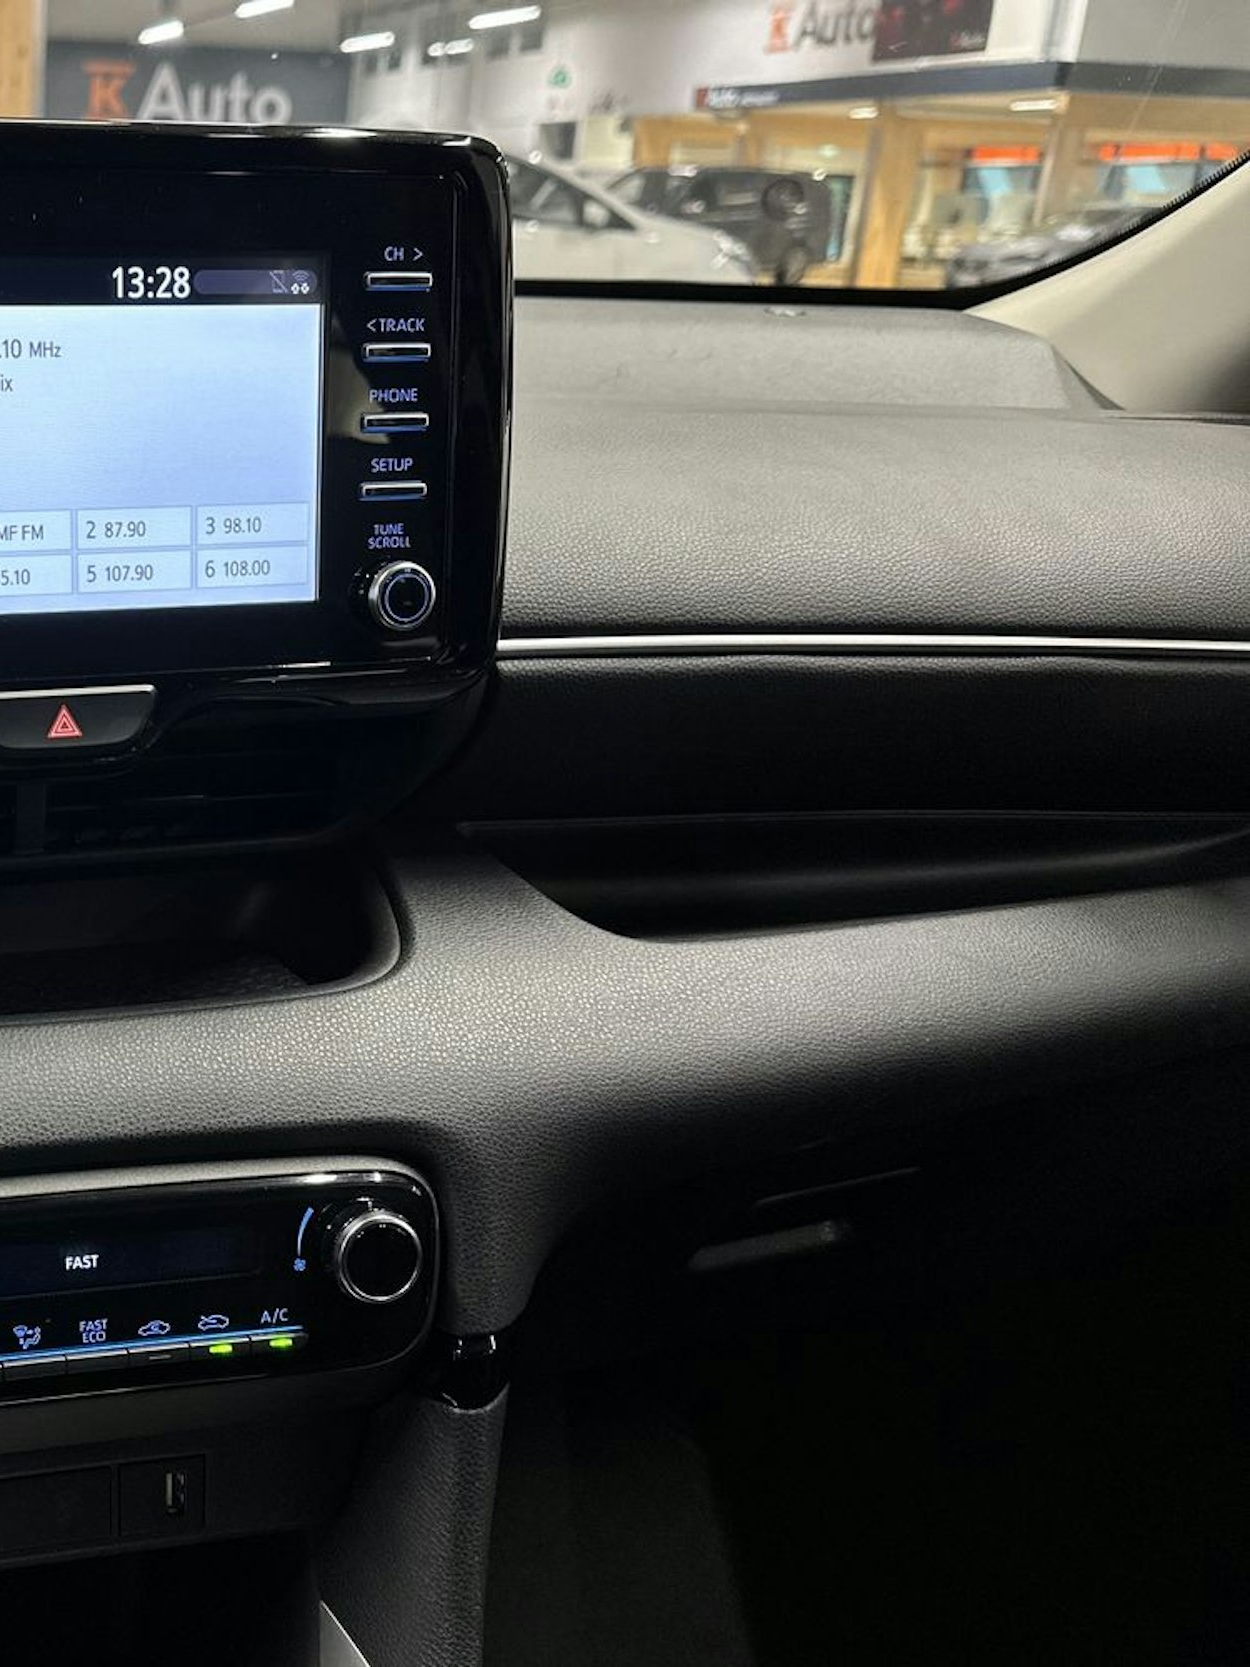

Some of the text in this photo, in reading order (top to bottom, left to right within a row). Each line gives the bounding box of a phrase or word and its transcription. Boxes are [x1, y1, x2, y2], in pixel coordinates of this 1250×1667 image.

[136, 62, 292, 124] Auto
[384, 246, 405, 261] CH
[111, 266, 191, 299] 13:28
[29, 341, 61, 358] MHz
[368, 388, 419, 403] PHONE
[370, 457, 414, 473] SETUP
[21, 524, 44, 541] FM
[85, 520, 147, 540] 2 87.90
[205, 516, 262, 535] 3 98.10
[374, 523, 404, 536] TUNE
[368, 536, 411, 550] SCROLL
[86, 564, 154, 583] 5 107.90
[204, 559, 271, 578] 6 108.00
[65, 1254, 100, 1270] FAST
[260, 1308, 289, 1324] A/C
[79, 1318, 108, 1332] FAST
[82, 1331, 106, 1344] ECO
